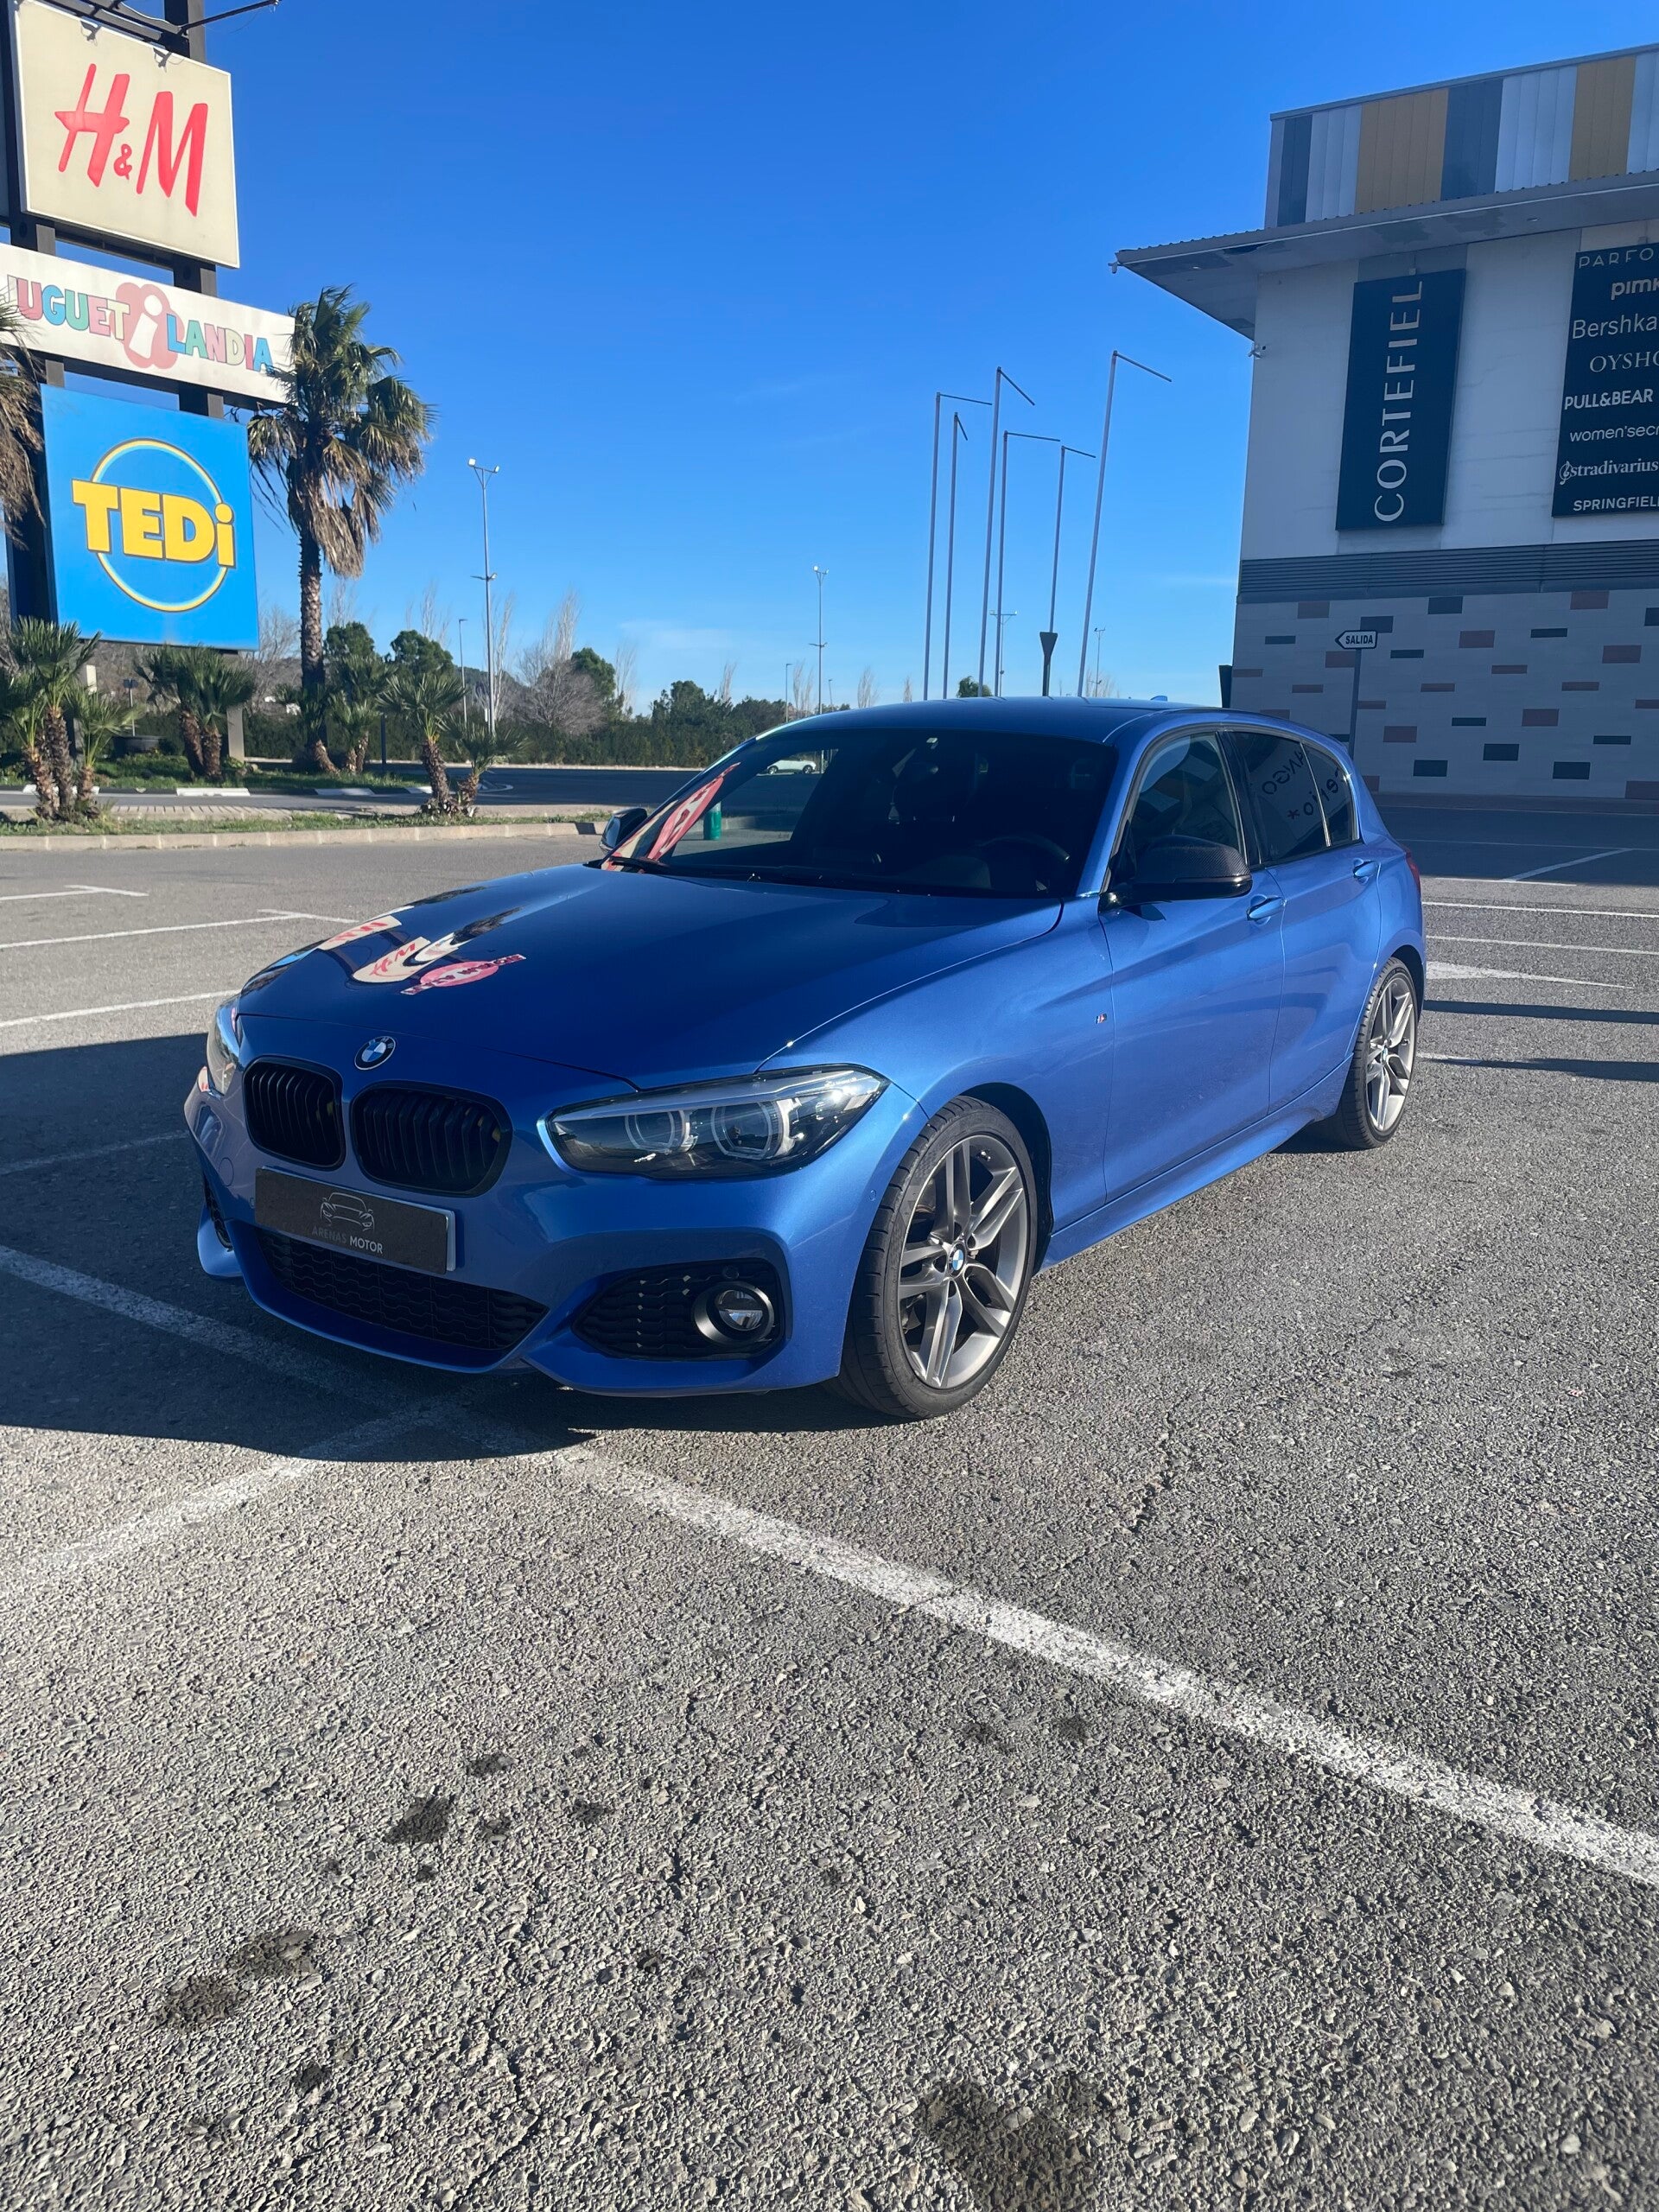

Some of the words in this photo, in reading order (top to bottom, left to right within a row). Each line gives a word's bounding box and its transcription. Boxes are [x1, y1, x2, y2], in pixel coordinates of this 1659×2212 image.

[54, 63, 208, 217] H&M
[1572, 313, 1657, 339] Bershka
[1374, 281, 1423, 522] CORTEFIEL
[1564, 389, 1654, 410] PULL&BEAR
[1568, 458, 1659, 478] stradivarius
[1573, 496, 1659, 512] SPRINGFIEL
[72, 479, 236, 569] TEDi
[1345, 634, 1374, 645] SALIDA
[312, 1225, 346, 1244] ARENAS
[349, 1236, 383, 1255] MOTOR
